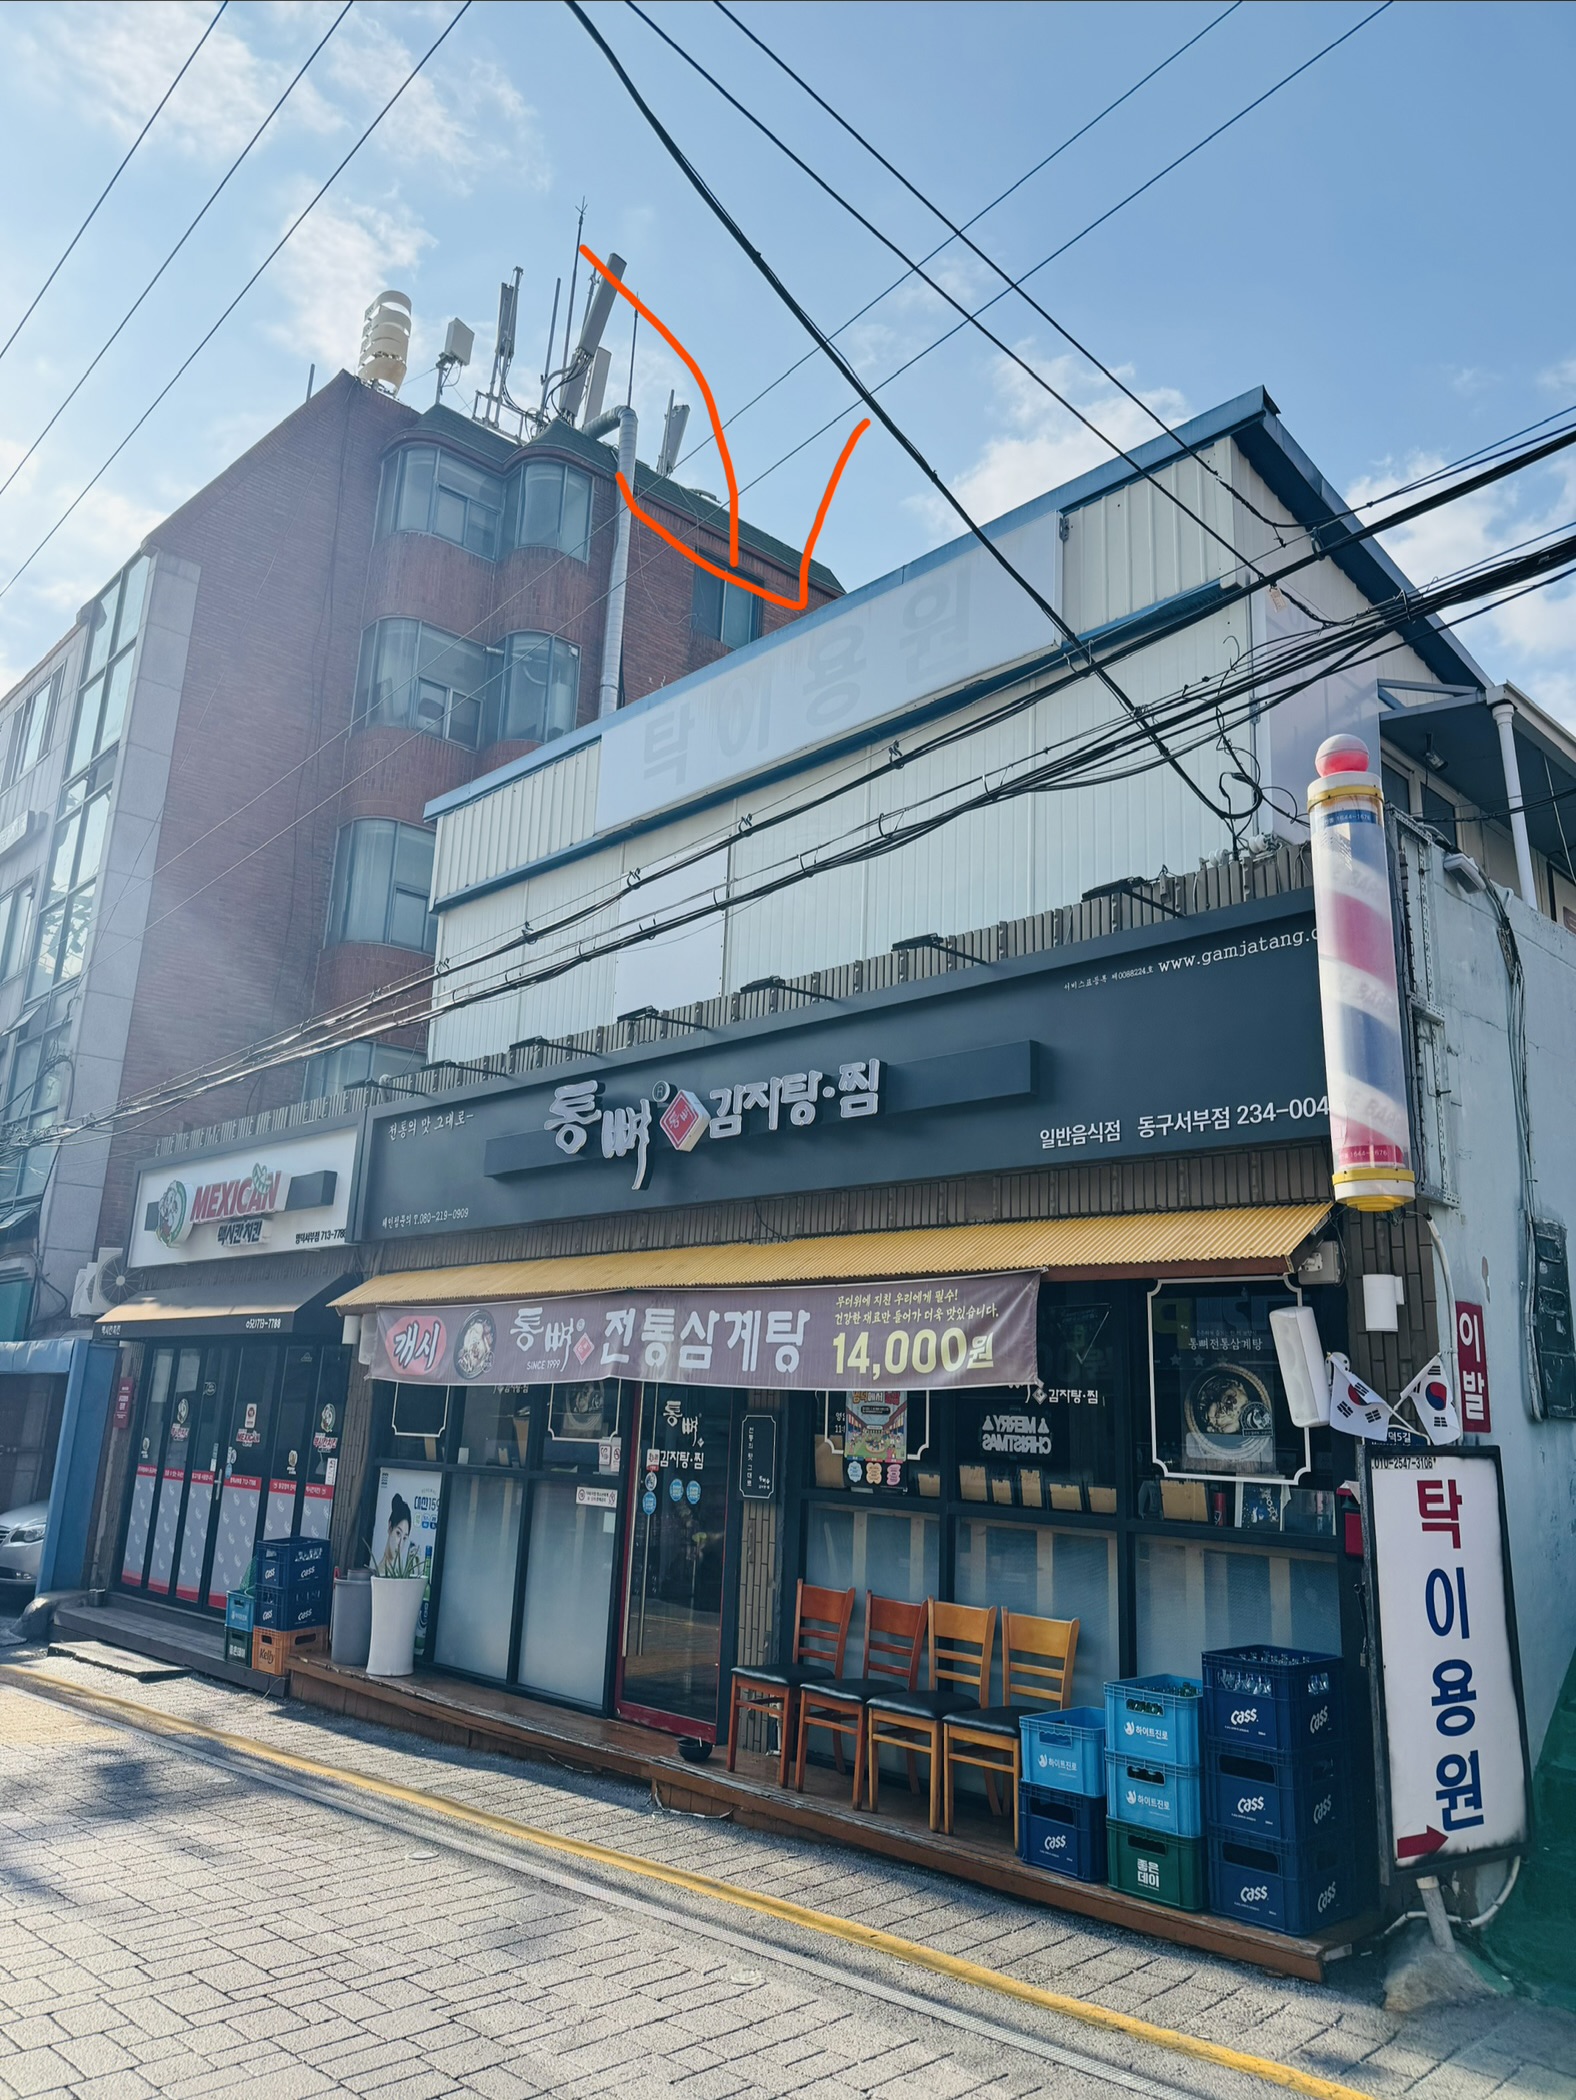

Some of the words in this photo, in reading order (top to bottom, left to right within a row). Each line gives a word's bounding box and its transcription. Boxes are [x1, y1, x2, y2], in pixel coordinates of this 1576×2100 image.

[388, 1119, 417, 1141] 전통의
[421, 1115, 431, 1135] 맛
[1039, 1120, 1121, 1149] 일반음식점
[1137, 1107, 1230, 1138] 동구서부점
[190, 1171, 282, 1222] MEXICAN
[836, 1294, 871, 1308] 무더위에
[873, 1293, 891, 1306] 지친
[894, 1291, 932, 1305] 우리에게
[935, 1289, 958, 1303] 필수!
[835, 1312, 861, 1326] 건강한
[862, 1311, 890, 1324] 재료만
[892, 1308, 921, 1324] 들어가
[924, 1307, 943, 1322] 더욱
[600, 1308, 810, 1373] 전통삼계탕
[833, 1327, 994, 1380] 14,000원
[1459, 1312, 1485, 1421] 이발
[259, 1648, 275, 1664] Kelly
[1416, 1479, 1485, 1832] 탁이용원
[1135, 1726, 1168, 1740] 하이트진로
[1137, 1794, 1170, 1811] 하이트진로
[1137, 1858, 1159, 1873] 좋은
[1137, 1873, 1159, 1887] 데이
